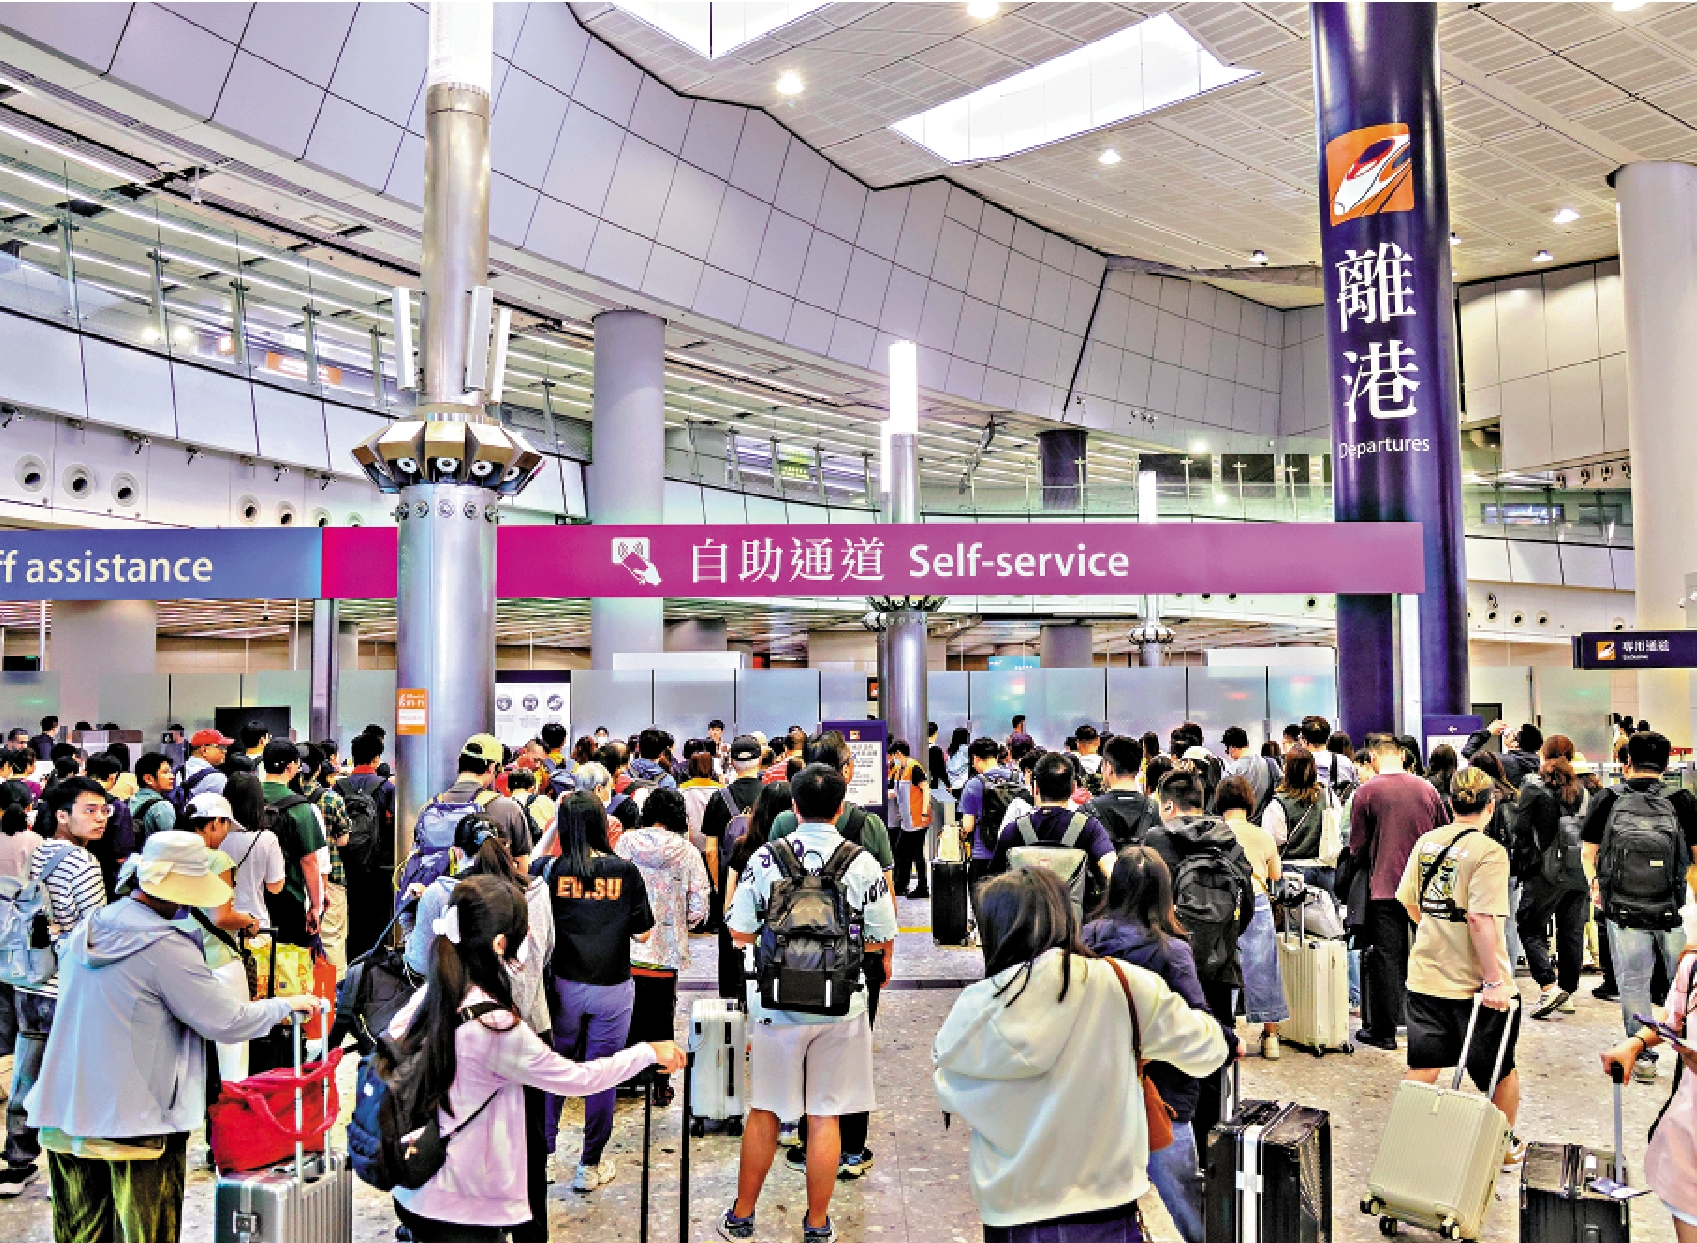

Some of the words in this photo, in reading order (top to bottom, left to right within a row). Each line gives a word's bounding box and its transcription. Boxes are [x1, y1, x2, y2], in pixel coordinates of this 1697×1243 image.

[1335, 242, 1421, 422] 離港
[1339, 437, 1430, 459] Departures
[26, 550, 213, 583] assistance
[691, 537, 885, 583] 自助通道
[909, 542, 1129, 578] Self-service
